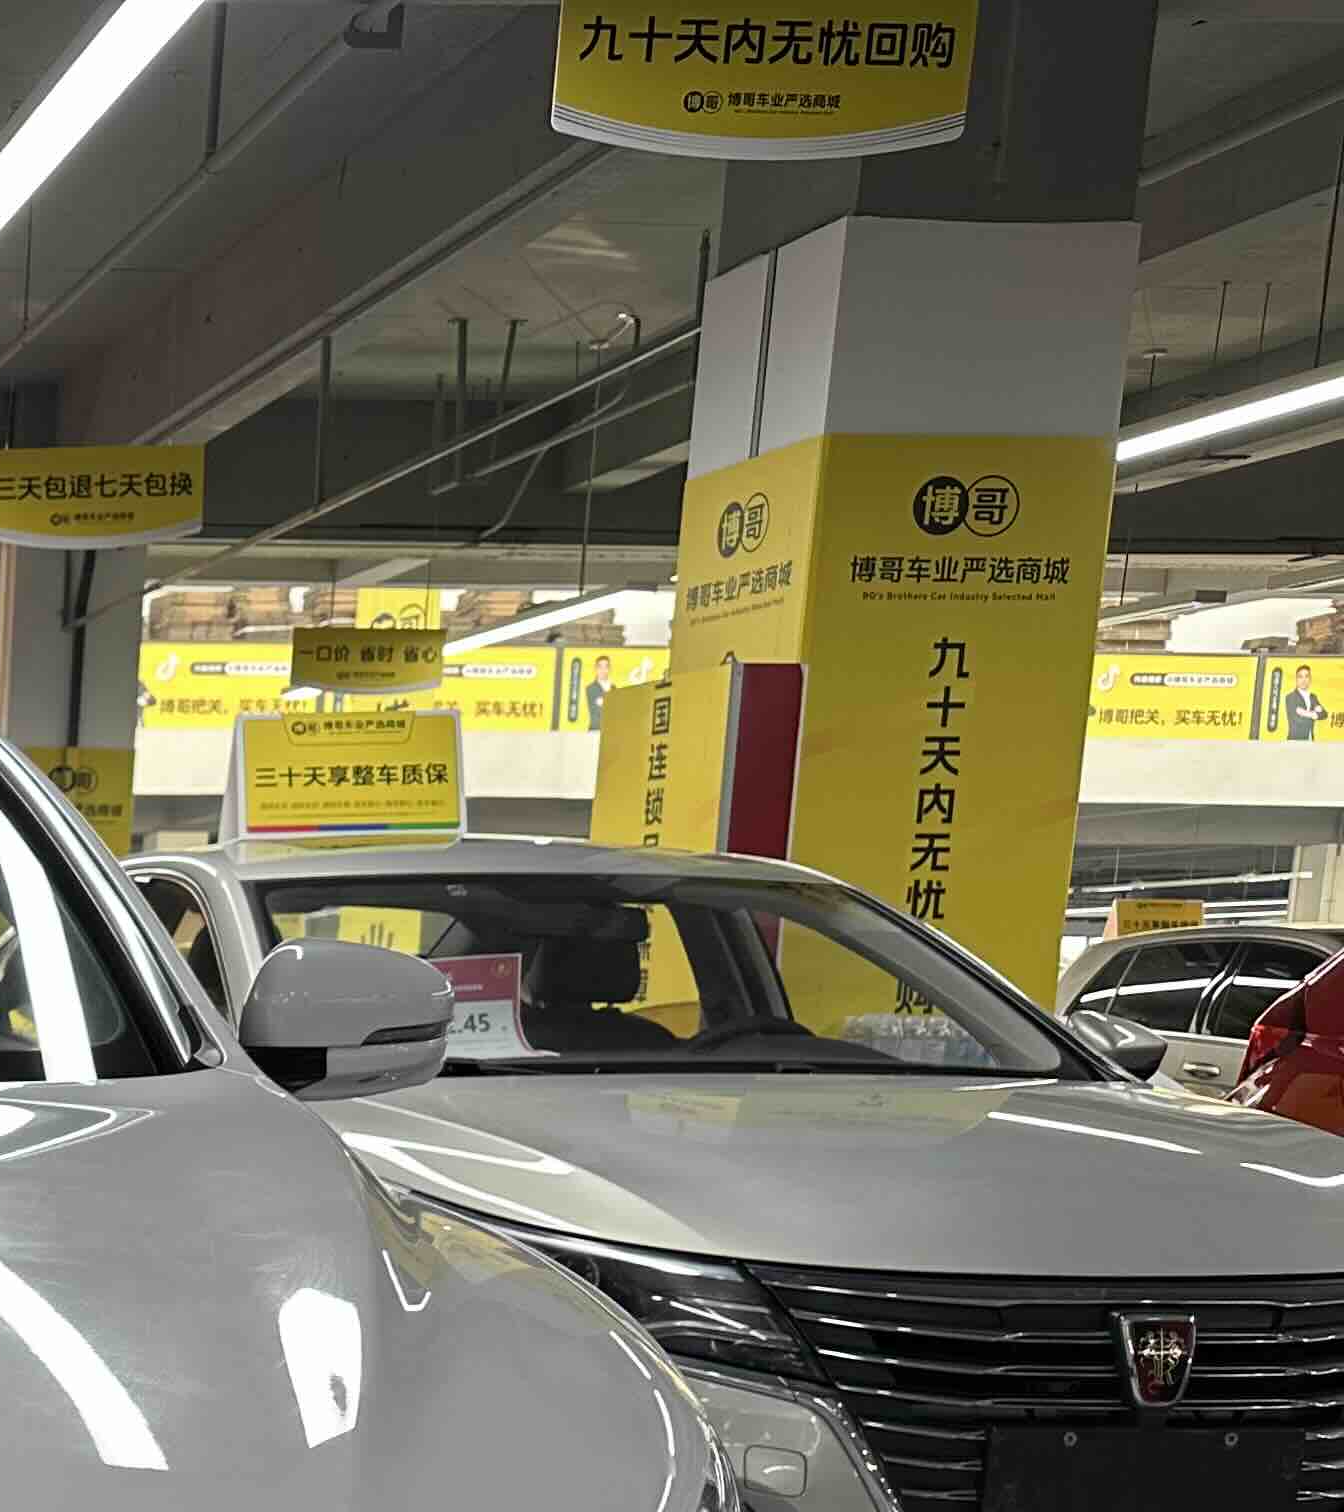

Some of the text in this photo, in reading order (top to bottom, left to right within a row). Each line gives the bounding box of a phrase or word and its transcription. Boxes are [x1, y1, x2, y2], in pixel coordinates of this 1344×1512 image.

[579, 15, 955, 69] 九十天内无忧回购
[917, 480, 1016, 532] 博哥
[686, 560, 793, 612] 博哥车业严选商城
[850, 555, 1070, 584] 博哥车业严选商城
[255, 762, 449, 788] 三十天享整车质保
